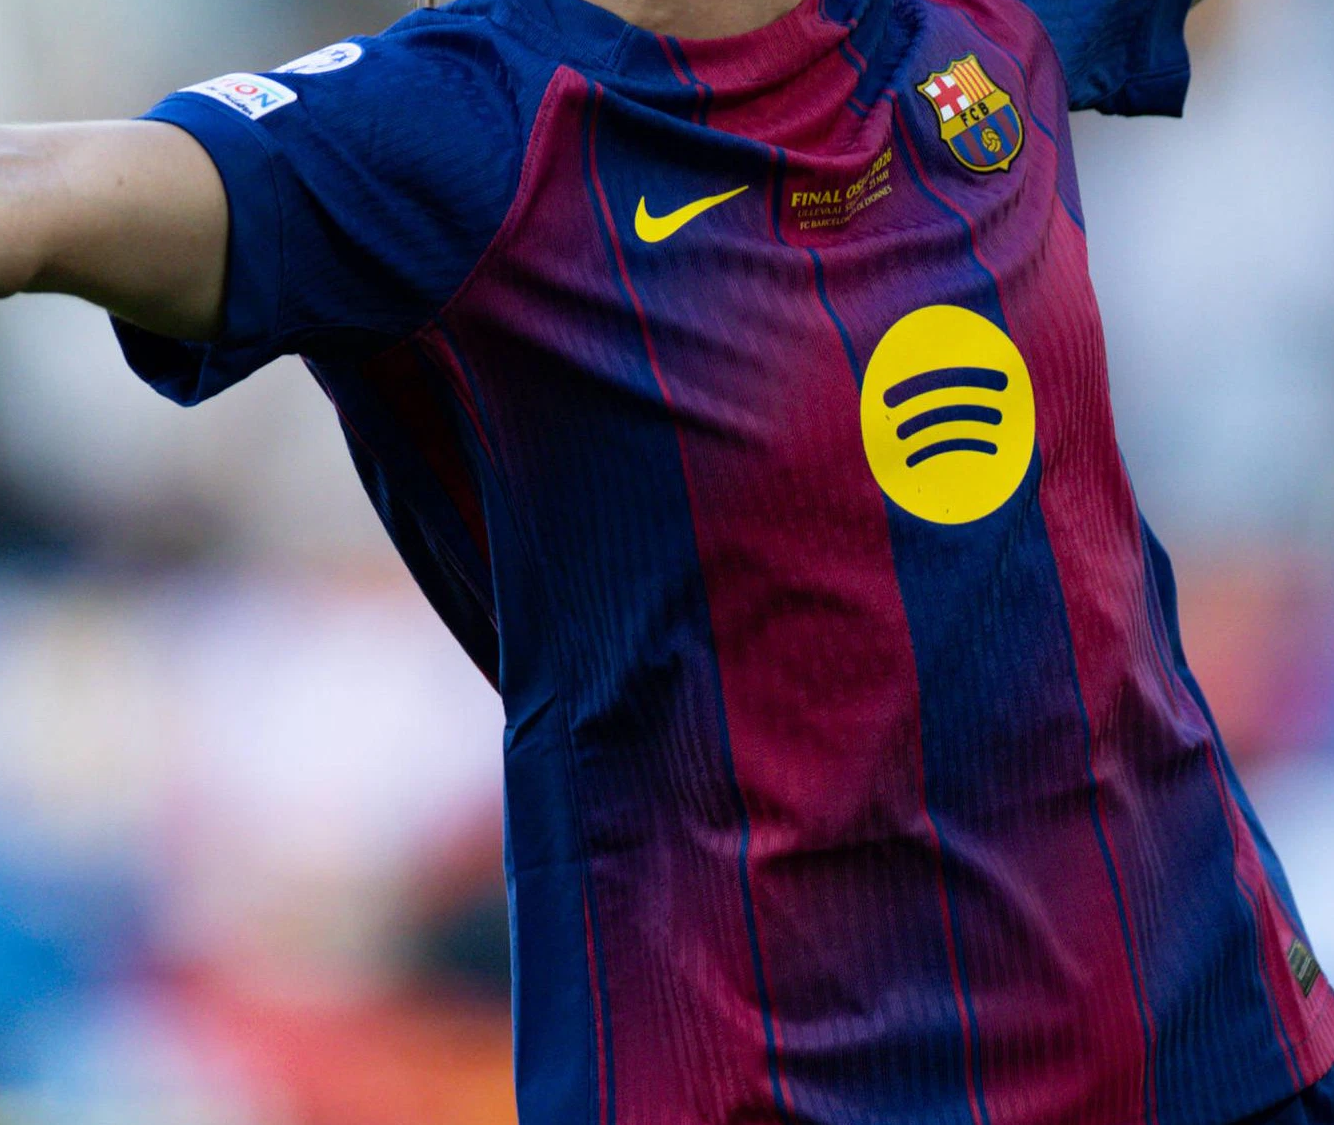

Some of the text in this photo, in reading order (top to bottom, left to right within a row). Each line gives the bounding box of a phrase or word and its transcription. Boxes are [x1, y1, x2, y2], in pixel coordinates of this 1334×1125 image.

[960, 102, 989, 127] FCB
[791, 189, 842, 207] FINAL
[870, 147, 892, 177] 2026
[800, 221, 810, 230] FC
